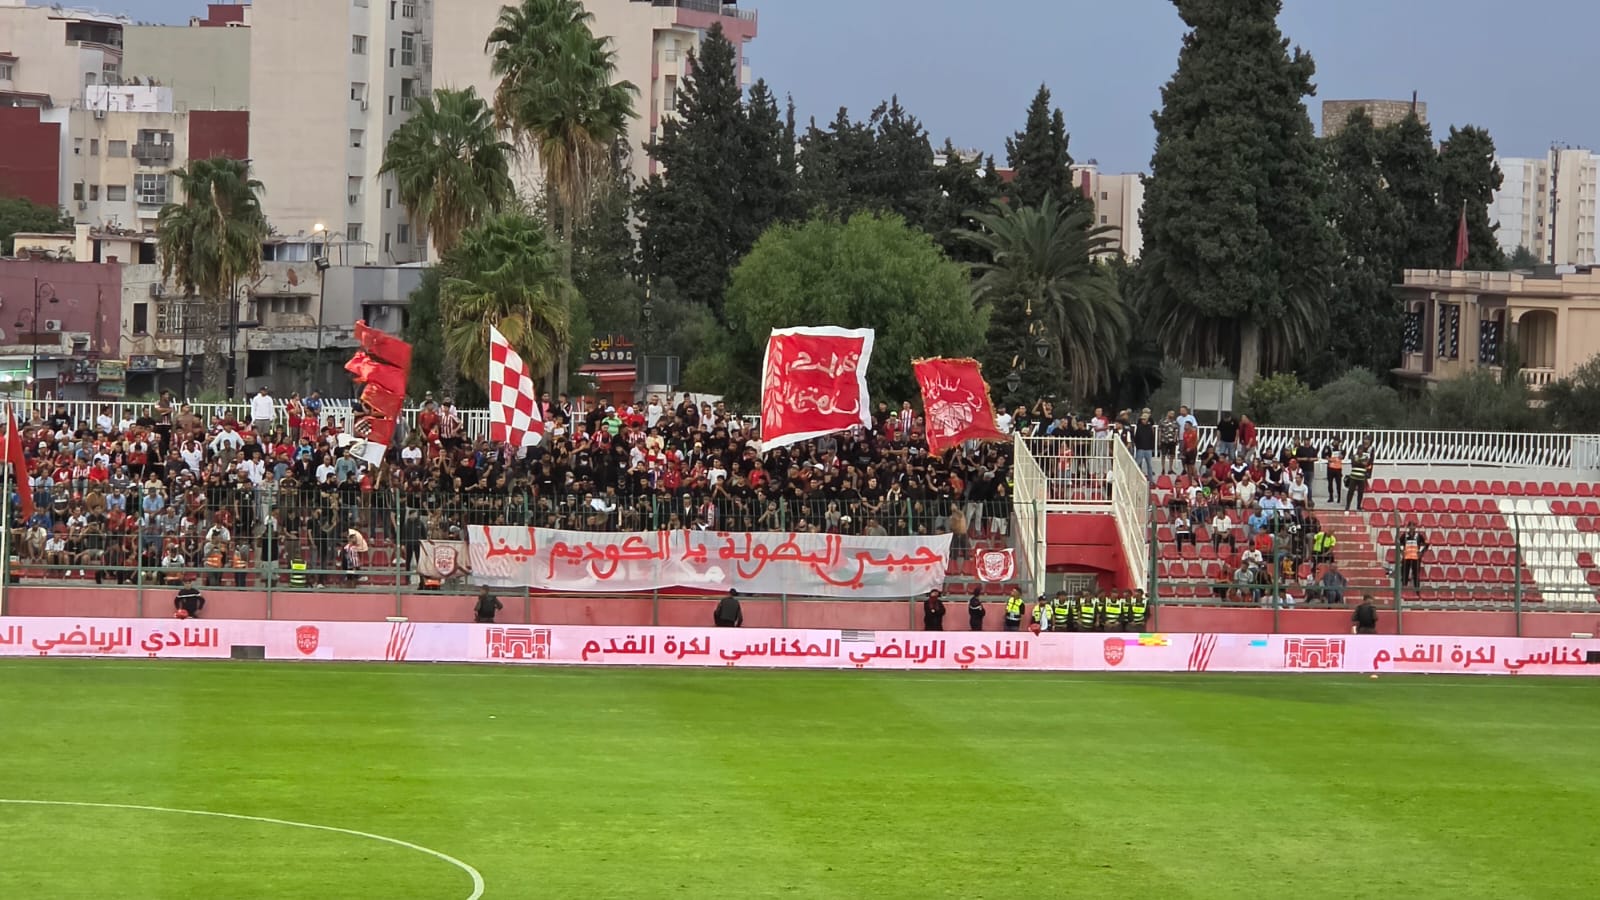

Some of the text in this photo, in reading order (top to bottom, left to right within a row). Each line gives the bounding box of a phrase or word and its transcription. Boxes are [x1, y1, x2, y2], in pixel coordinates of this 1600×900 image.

[483, 526, 537, 562] لينا
[545, 530, 671, 580] الكوديم
[680, 528, 707, 564] يا
[717, 532, 842, 580] البطولة
[815, 546, 943, 590] جيبي
[32, 625, 132, 656] الرياضي
[141, 627, 219, 657] النادي
[581, 635, 1029, 669] النادي الرياضي المكناسي لكرة القدم
[1373, 644, 1443, 670] القدم
[1451, 645, 1495, 669] لكرة
